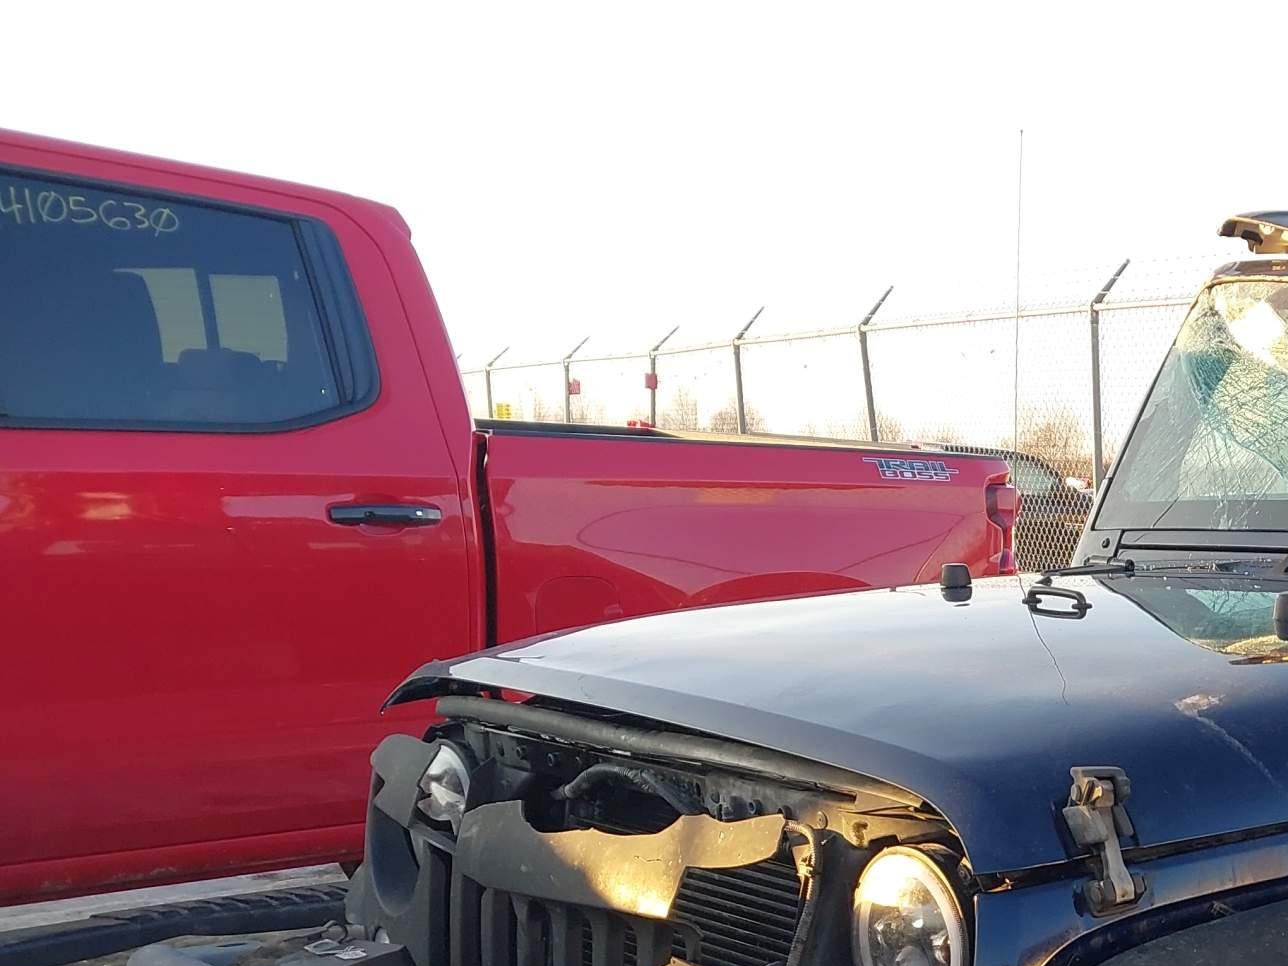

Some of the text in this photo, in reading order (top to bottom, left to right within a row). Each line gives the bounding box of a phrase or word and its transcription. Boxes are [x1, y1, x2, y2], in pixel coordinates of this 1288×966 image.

[0, 186, 180, 237] 4105630
[862, 457, 959, 474] TRAIL
[880, 469, 951, 482] BOSS
